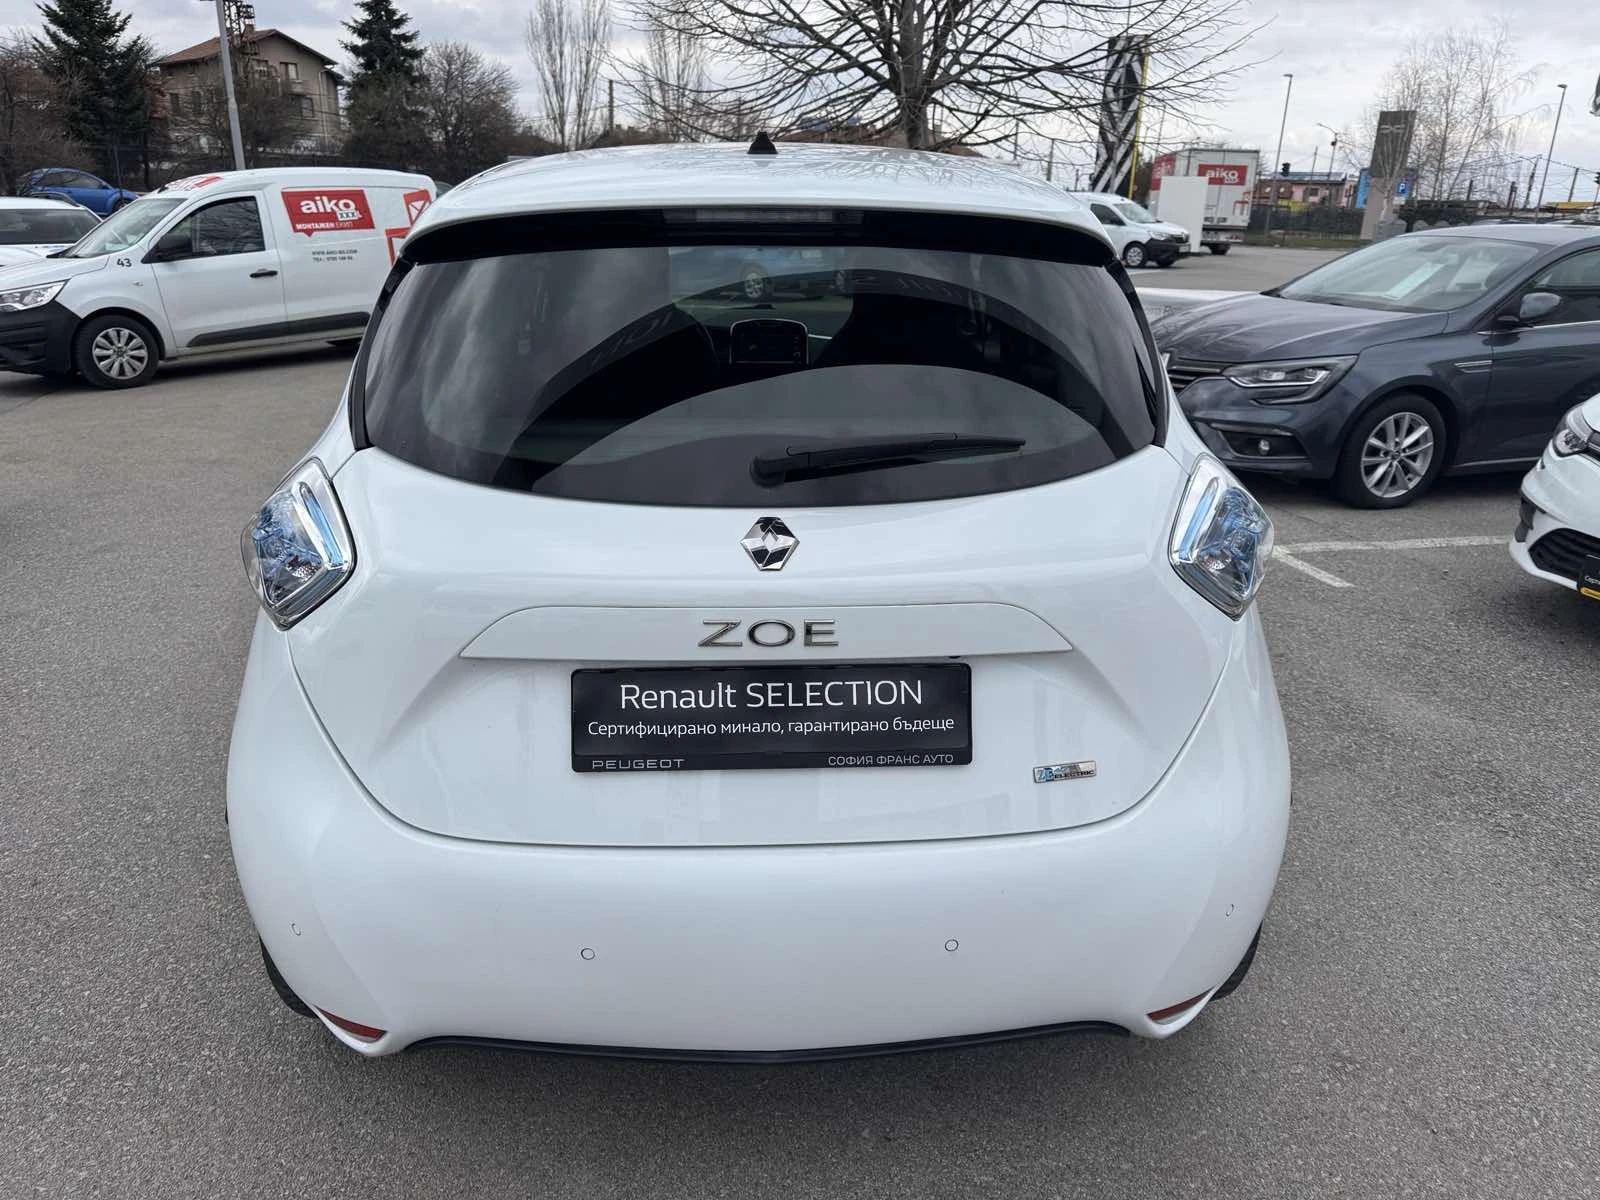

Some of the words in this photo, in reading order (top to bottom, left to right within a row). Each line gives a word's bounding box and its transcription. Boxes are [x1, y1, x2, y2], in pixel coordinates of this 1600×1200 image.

[1206, 167, 1238, 179] aiko
[300, 196, 356, 214] aiko
[117, 258, 131, 267] 43
[698, 618, 839, 647] ZOE
[620, 682, 737, 710] Renault
[746, 680, 923, 708] SELECTION
[588, 721, 717, 738] Сертифицирано
[721, 721, 784, 735] минало,
[788, 719, 889, 735] гарантирано
[893, 716, 955, 732] бъдеще
[592, 759, 685, 769] PEUGEOT
[828, 756, 873, 766] СОФИЯ
[876, 754, 920, 765] ФРАНС
[923, 754, 954, 764] АУТО
